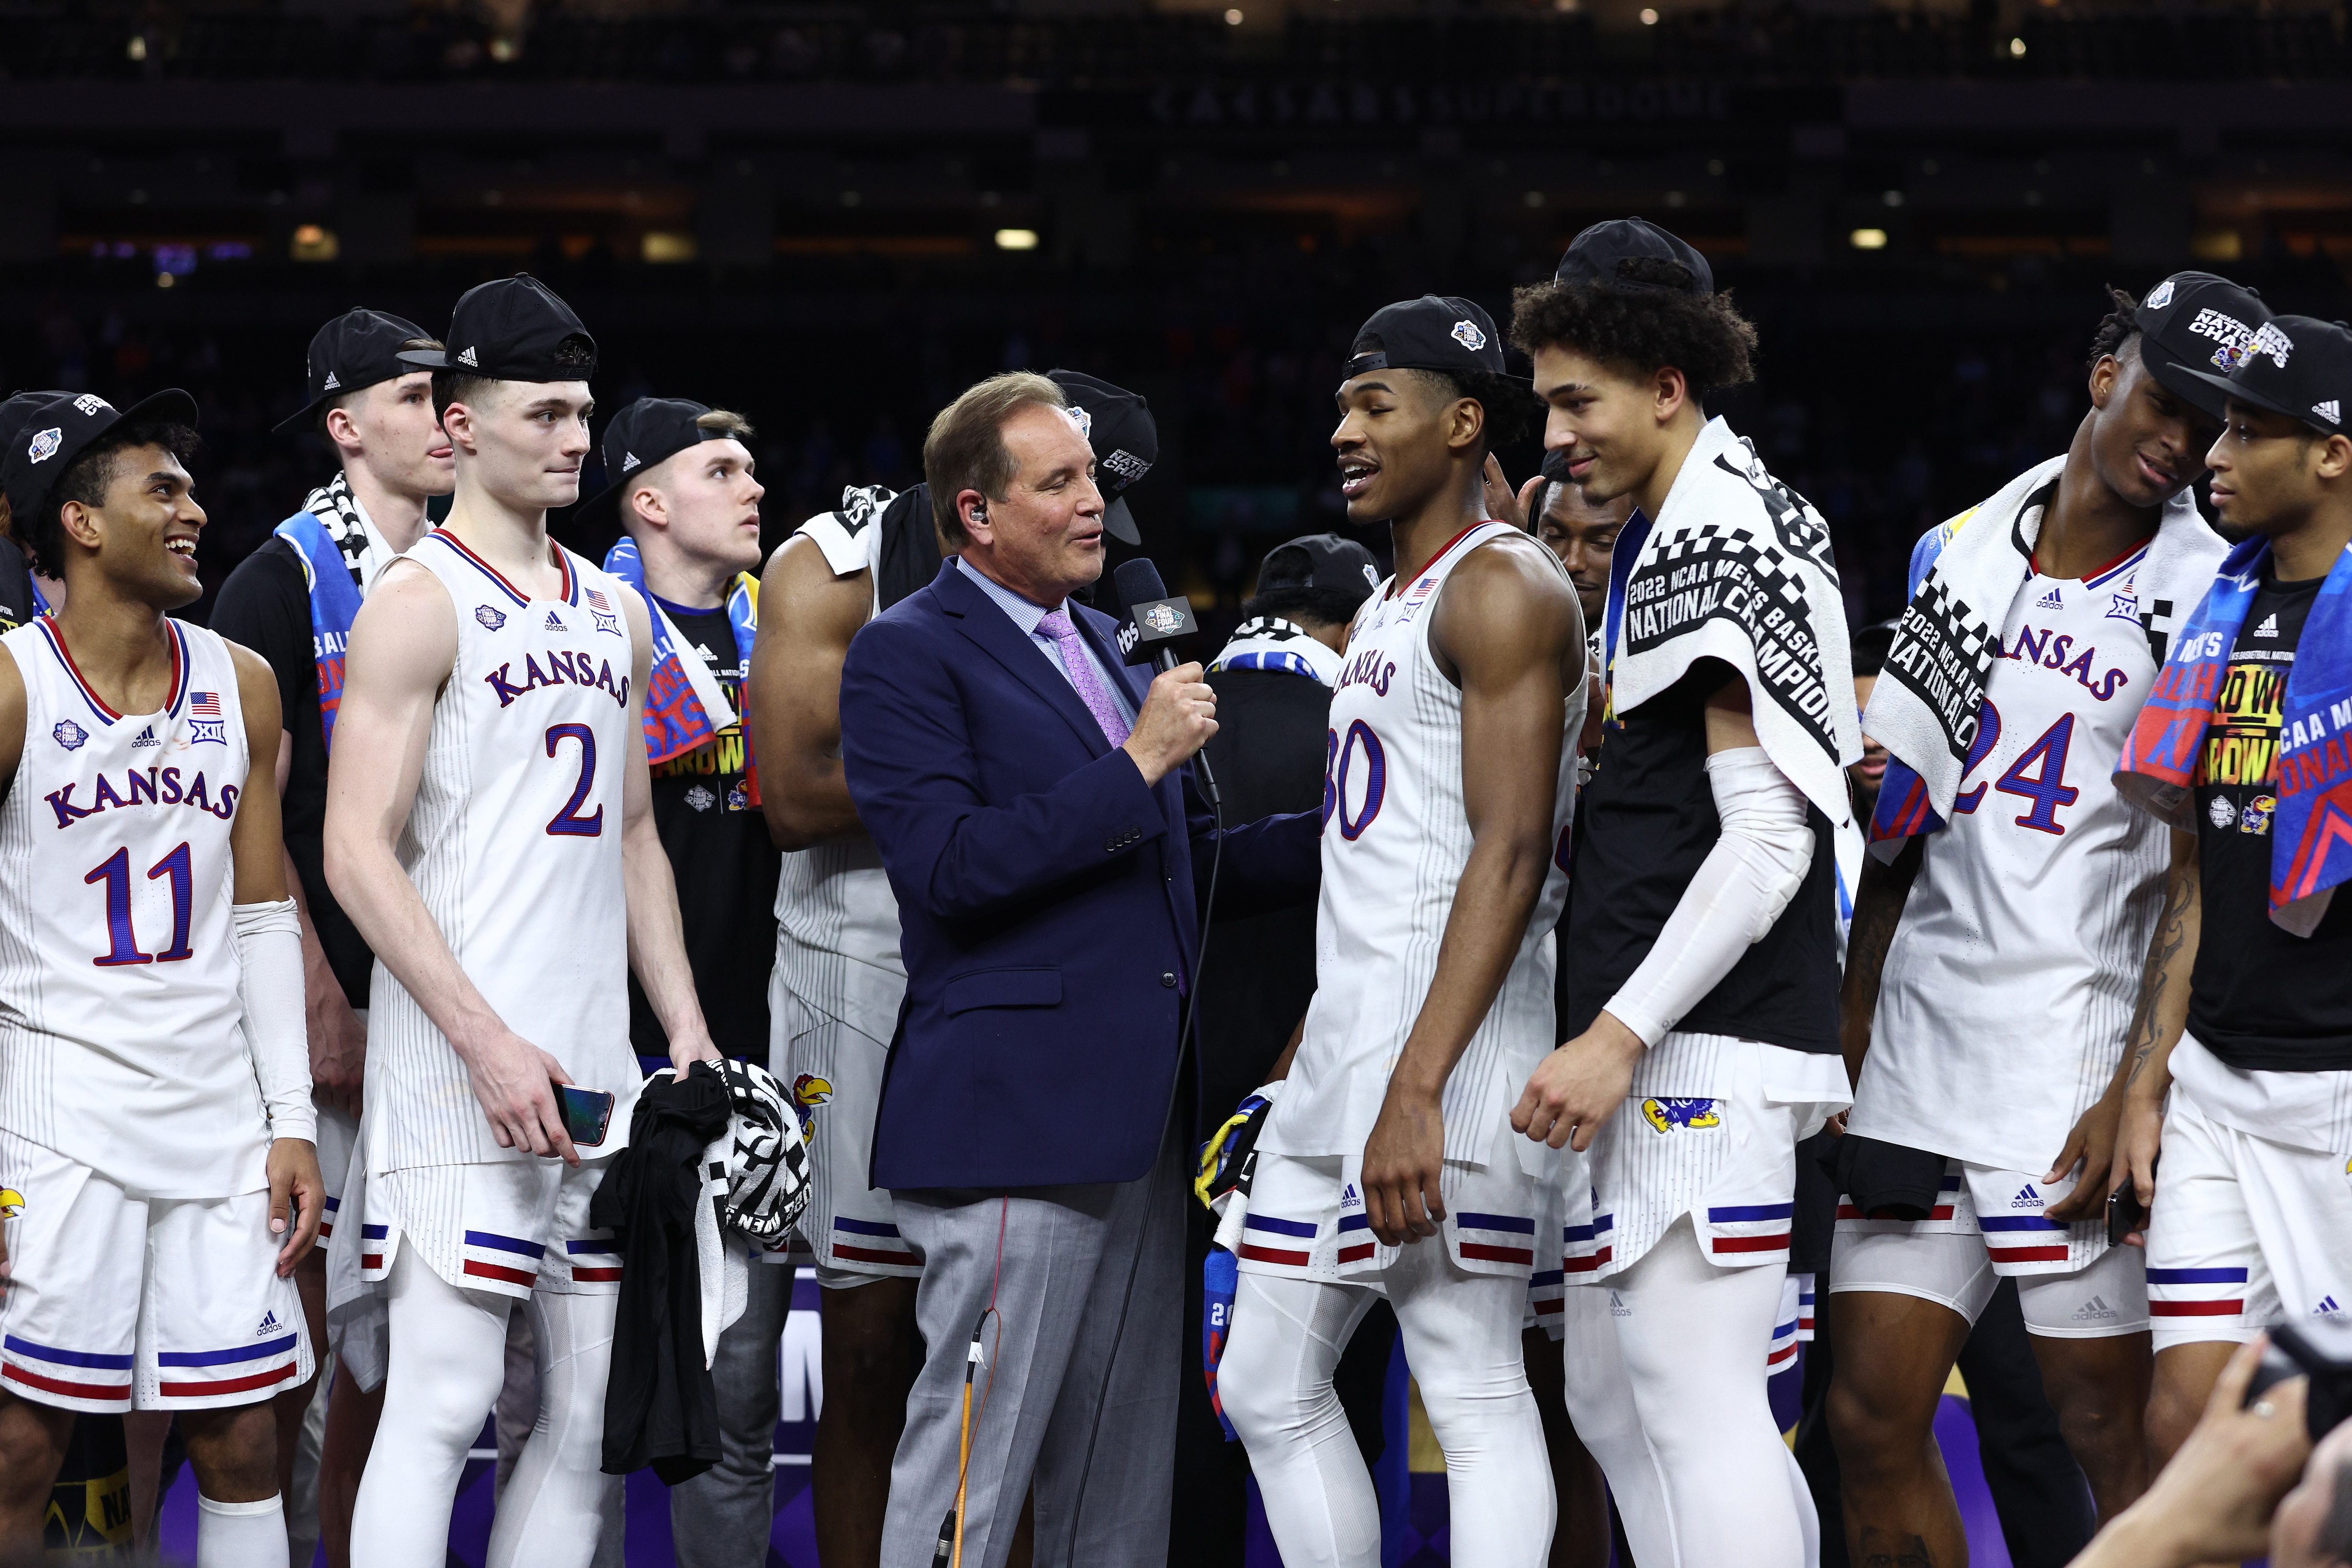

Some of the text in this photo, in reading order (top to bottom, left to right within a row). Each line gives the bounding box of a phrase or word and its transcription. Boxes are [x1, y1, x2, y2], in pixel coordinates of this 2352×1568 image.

[458, 356, 478, 367] adidas
[2312, 406, 2342, 425] adidas
[37, 434, 50, 450] FINAL
[40, 438, 53, 454] FOUR
[0, 605, 14, 617] PIONS
[2036, 601, 2064, 610] adidas
[1156, 611, 1174, 620] FINAL
[1157, 617, 1174, 628] FOUR
[1630, 558, 1825, 683] 2022 NCAA MEN'S BASKE
[1116, 621, 1139, 655] tbs
[1901, 605, 1941, 651] 2022
[1938, 640, 1970, 688] NCAA
[1629, 581, 1838, 743] NATIONAL CHAMPION
[485, 650, 630, 708] KANSAS
[132, 739, 161, 748] adidas
[1955, 697, 2079, 836] 24
[546, 723, 603, 836] 2
[44, 766, 239, 829] KANSAS
[85, 841, 193, 966] 11
[1341, 1196, 1361, 1207] adidas
[2011, 1197, 2044, 1208] adidas
[2071, 1307, 2118, 1321] adidas
[256, 1321, 283, 1337] adidas
